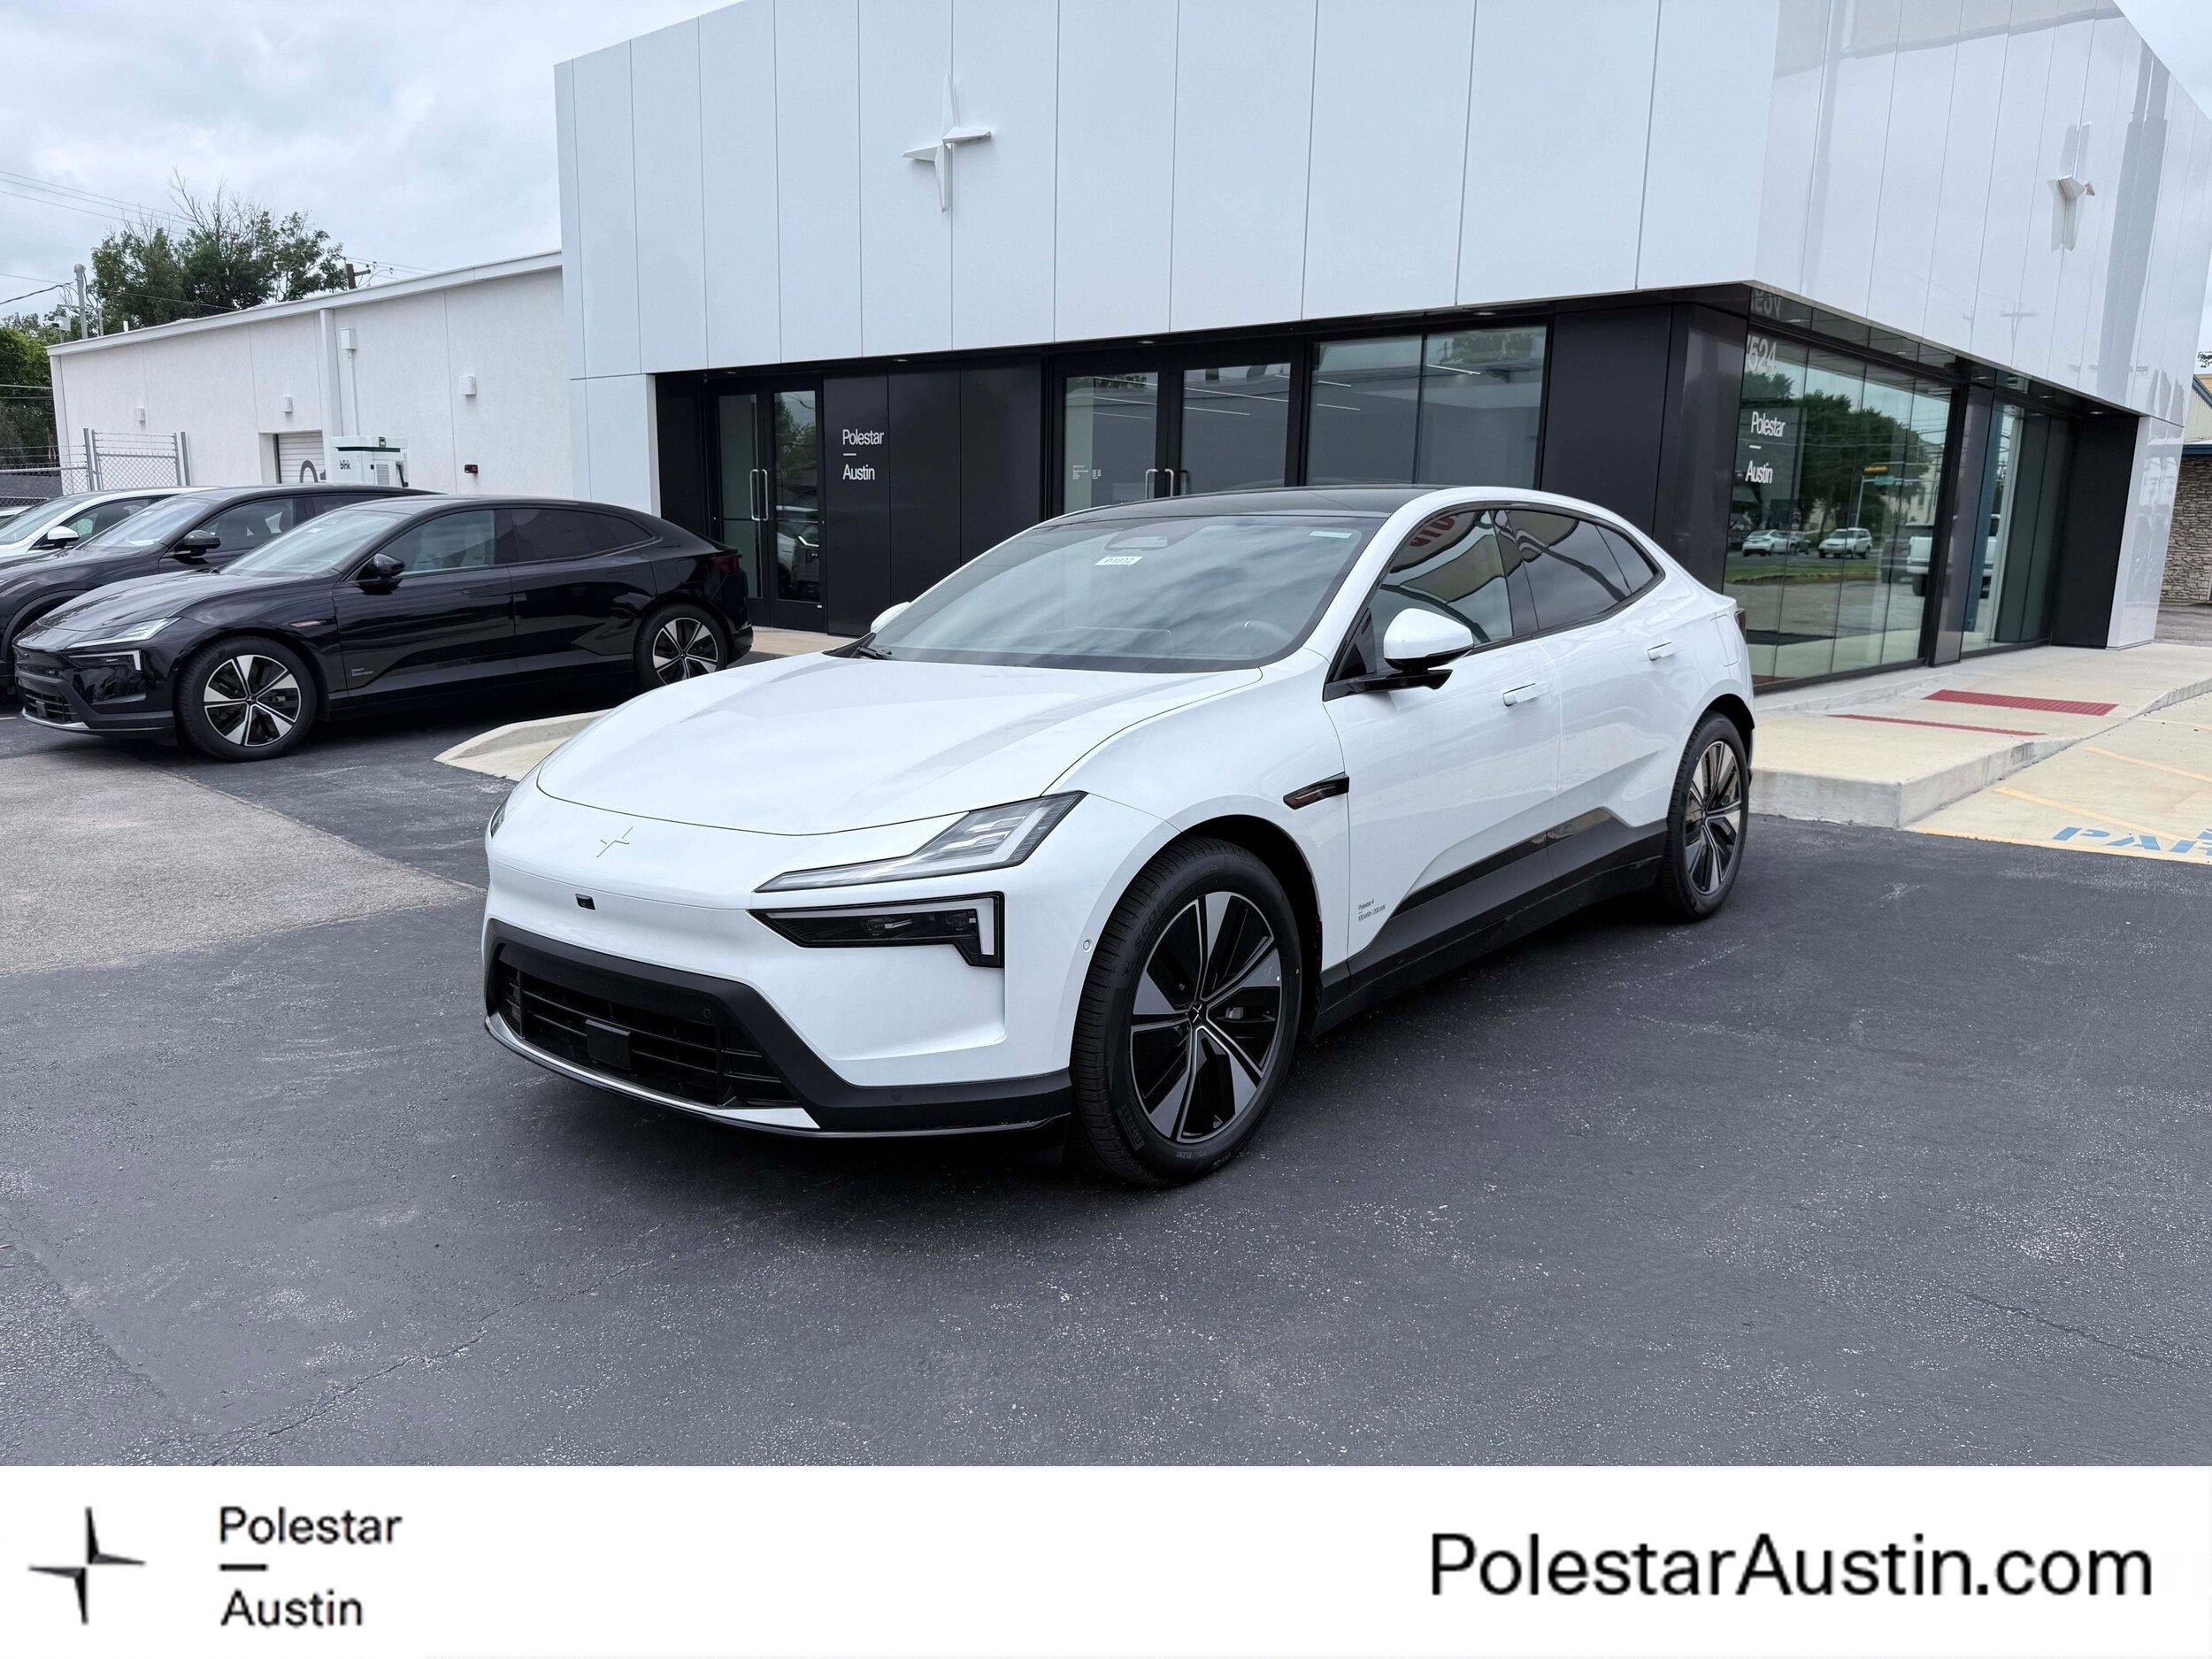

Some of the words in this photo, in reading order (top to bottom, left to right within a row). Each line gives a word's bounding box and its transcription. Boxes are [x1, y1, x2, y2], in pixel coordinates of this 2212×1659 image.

[1751, 411, 1786, 438] Polestar
[842, 428, 885, 445] Polestar
[842, 464, 875, 480] Austin
[1745, 459, 1774, 484] Austin
